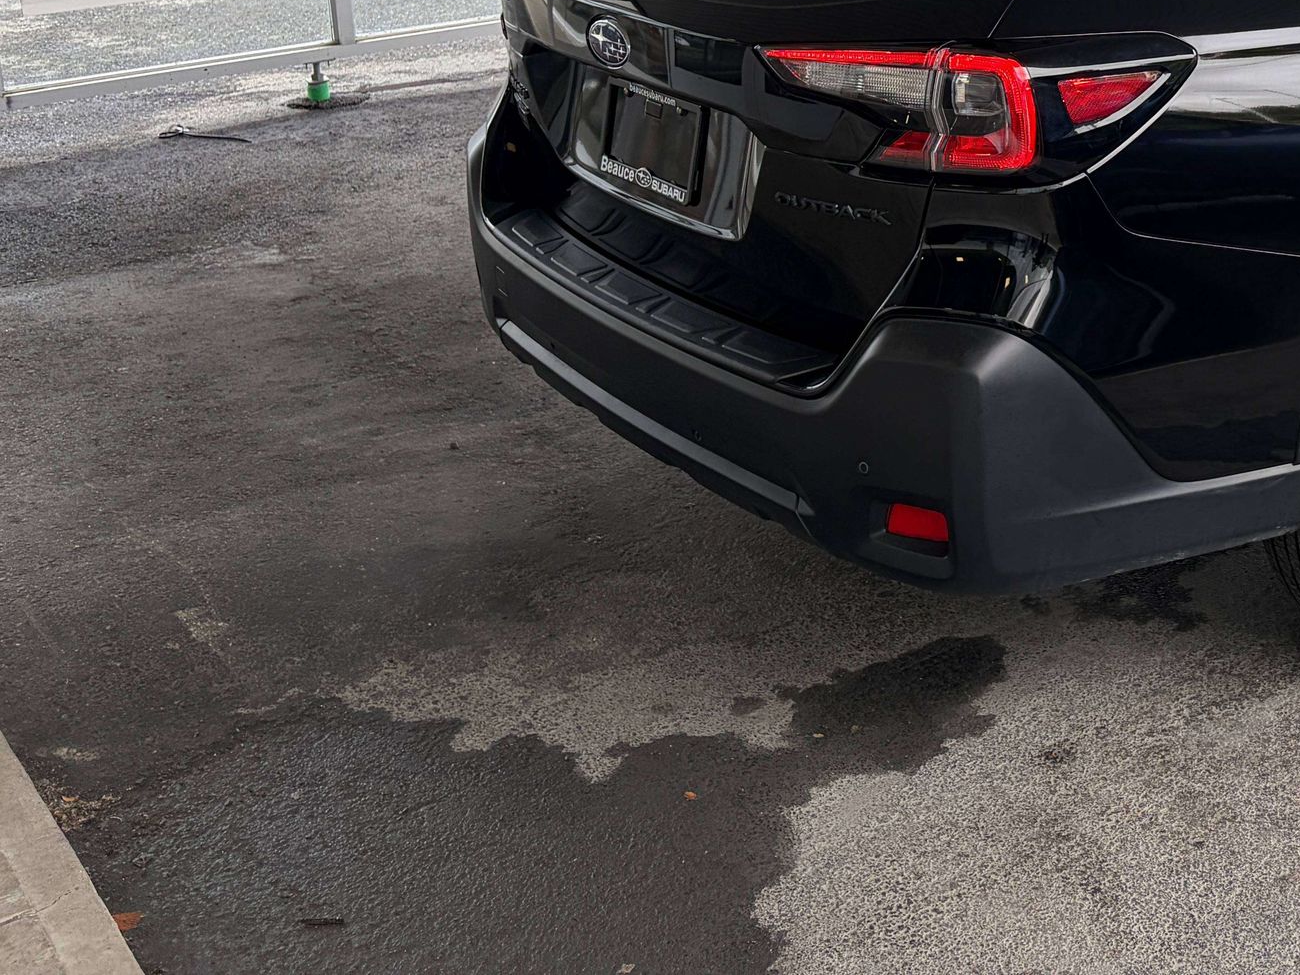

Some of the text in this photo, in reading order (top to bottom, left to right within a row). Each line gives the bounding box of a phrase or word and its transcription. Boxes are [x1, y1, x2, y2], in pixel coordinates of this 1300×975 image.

[628, 81, 677, 107] beaucesubaru.com
[600, 154, 687, 203] Beauce SUBARU
[774, 191, 893, 226] OUTBACK
